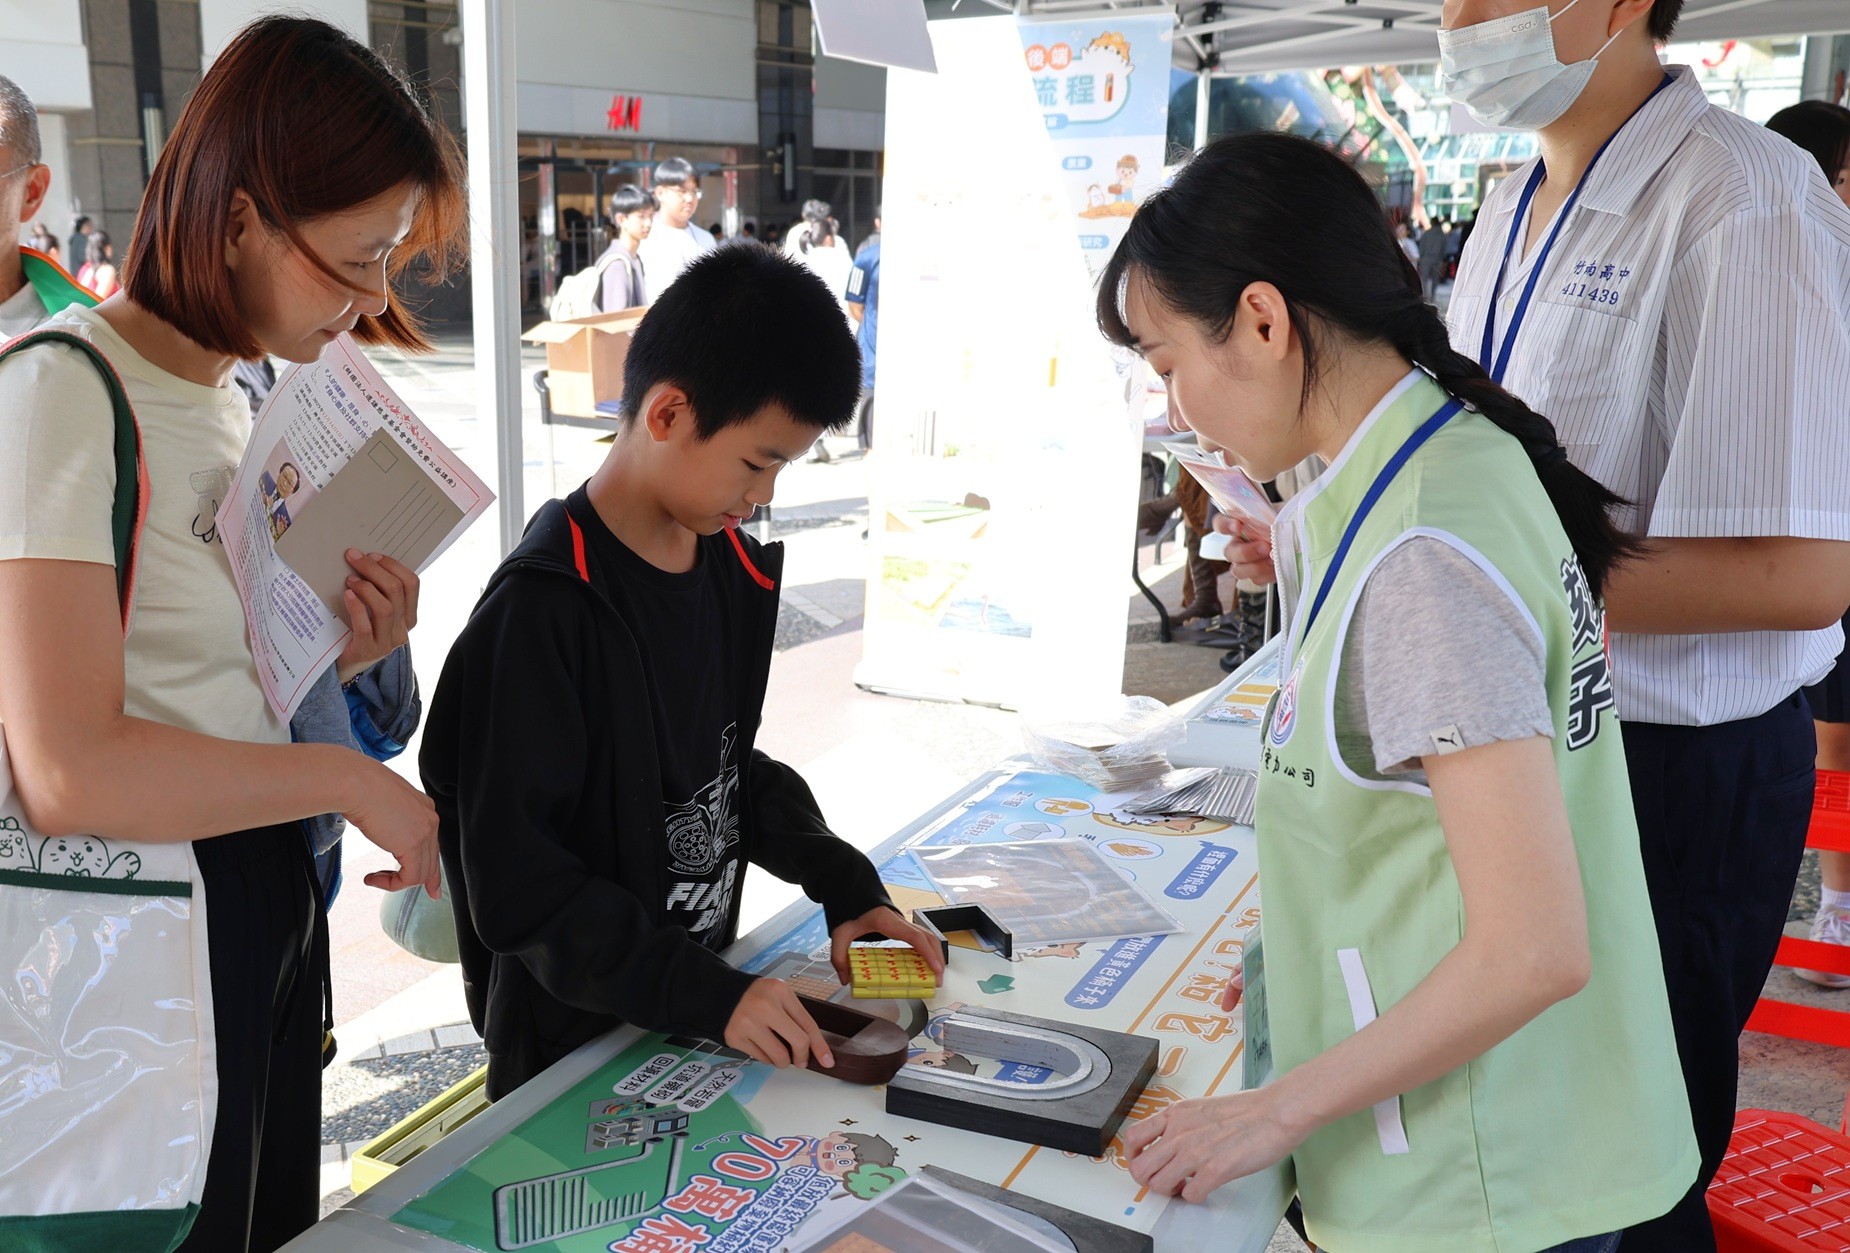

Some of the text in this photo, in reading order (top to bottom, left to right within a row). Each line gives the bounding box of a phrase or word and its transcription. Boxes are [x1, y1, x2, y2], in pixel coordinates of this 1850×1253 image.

[1573, 260, 1631, 285] 竹南高中
[1561, 282, 1620, 305] 411439
[619, 1056, 675, 1092] 回填材料
[683, 1070, 737, 1110] 天然岩層
